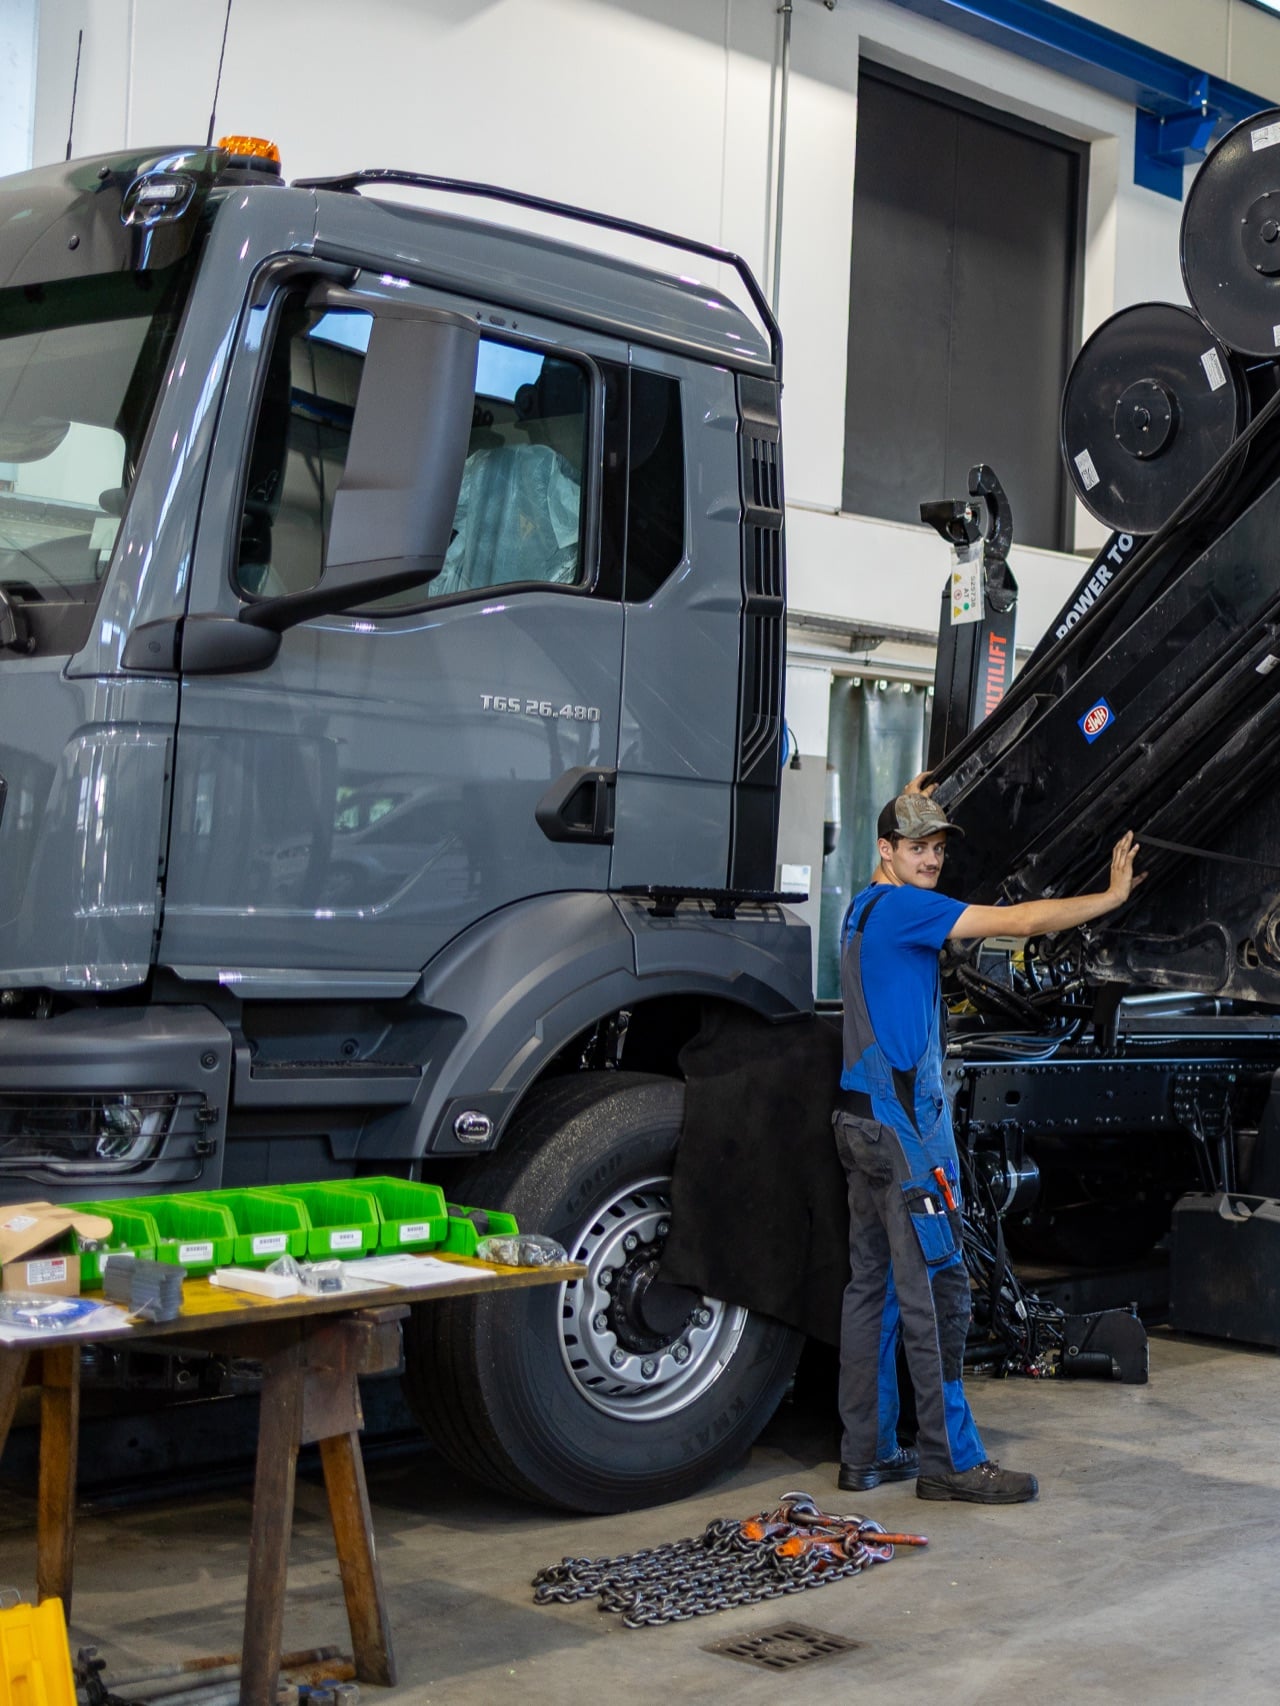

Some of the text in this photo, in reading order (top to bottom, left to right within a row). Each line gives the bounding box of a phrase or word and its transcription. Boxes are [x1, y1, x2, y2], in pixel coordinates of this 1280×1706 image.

[1055, 564, 1113, 640] POWER
[480, 694, 600, 721] TGS 26.480
[1087, 708, 1107, 731] HMF
